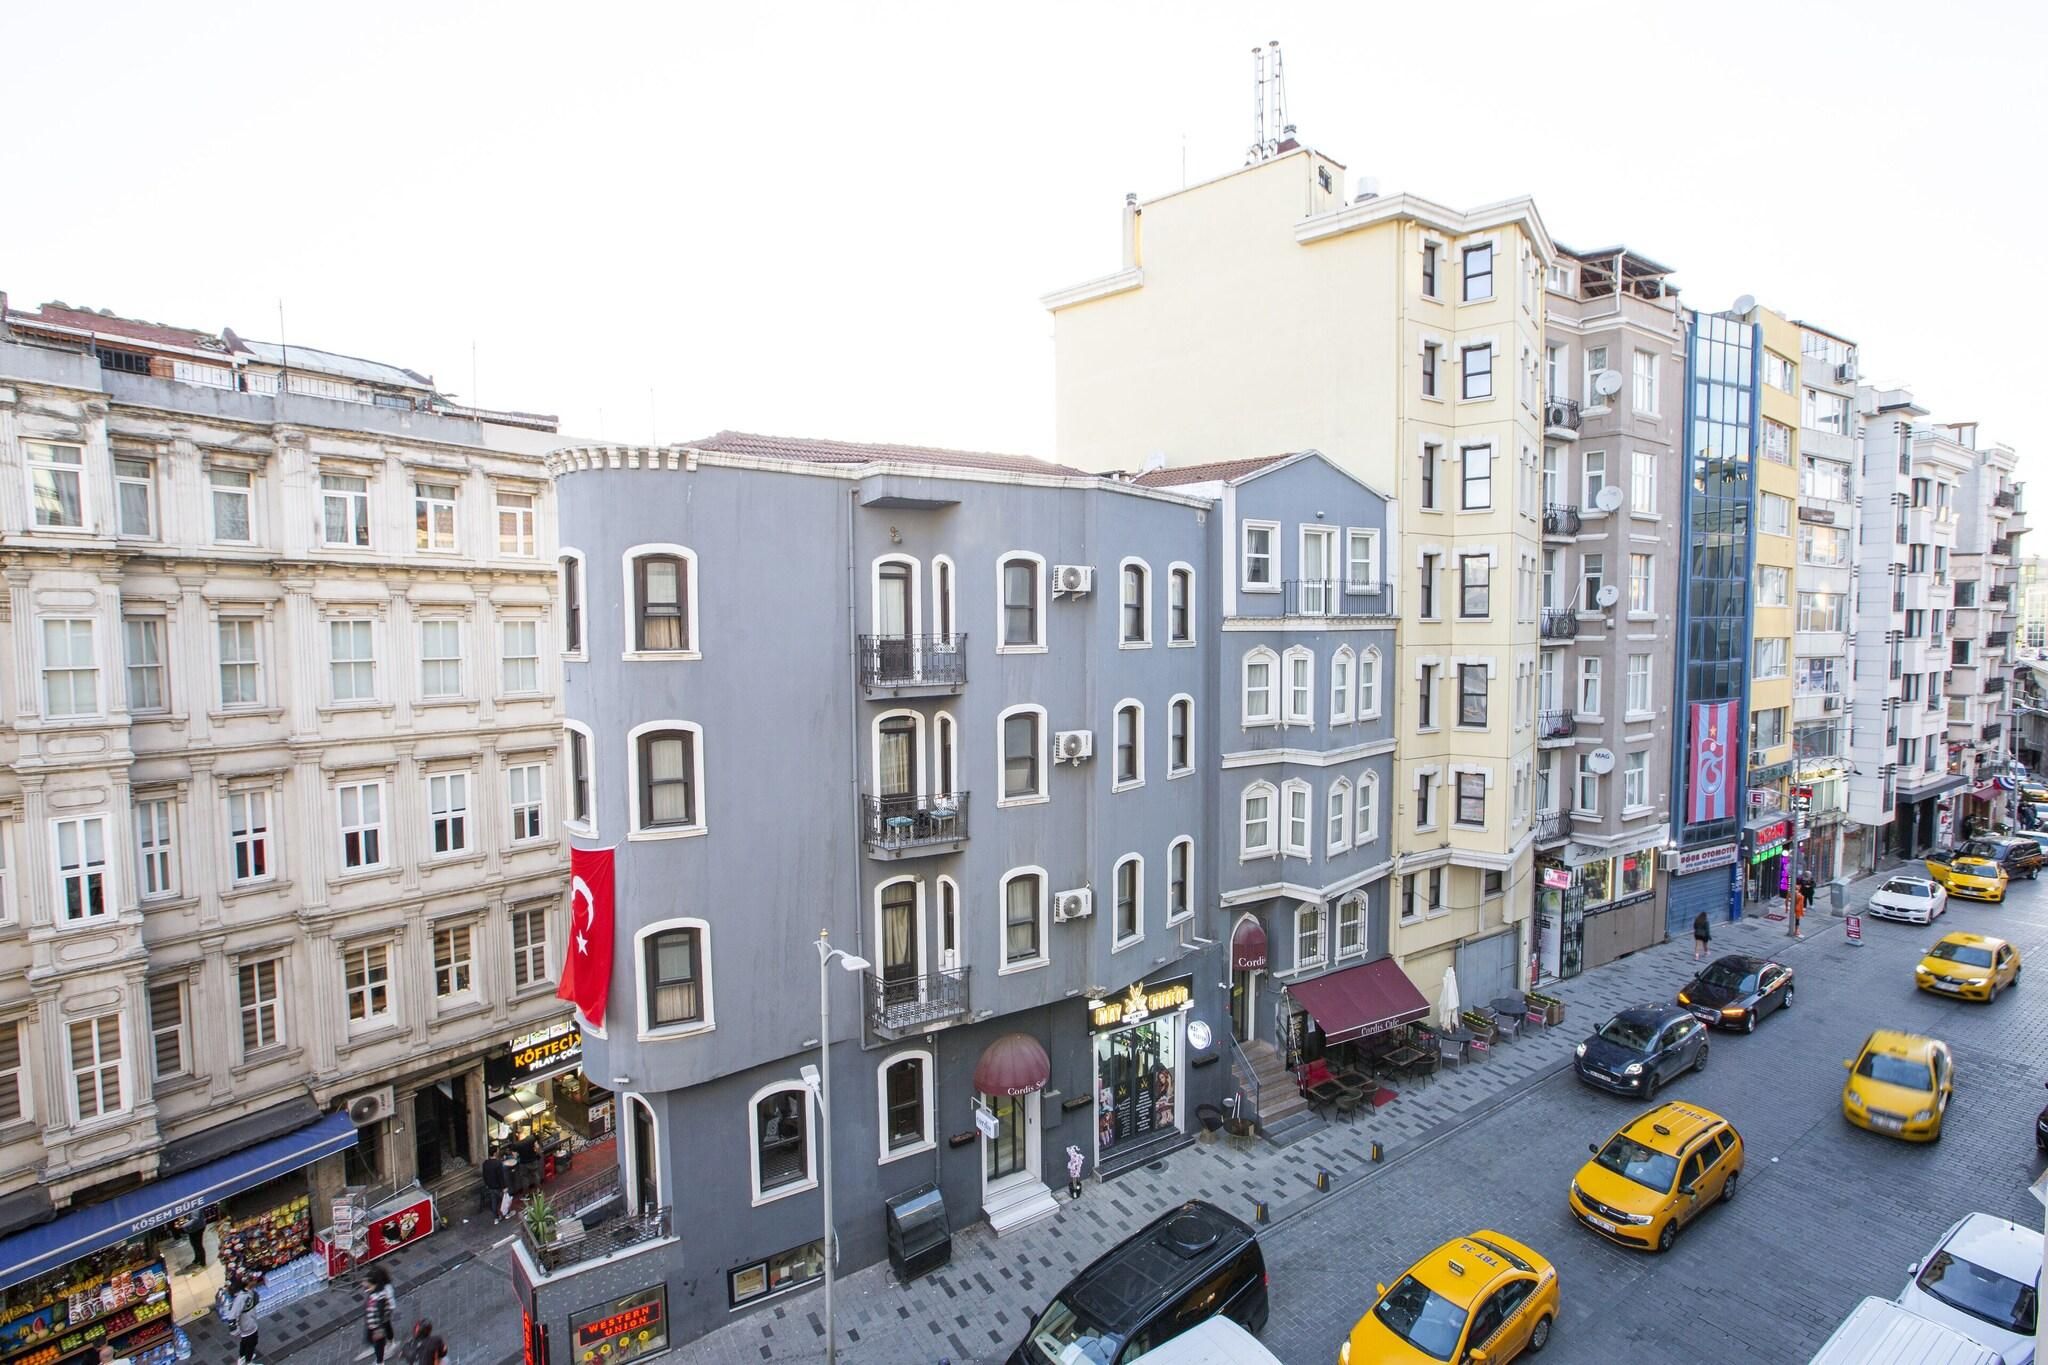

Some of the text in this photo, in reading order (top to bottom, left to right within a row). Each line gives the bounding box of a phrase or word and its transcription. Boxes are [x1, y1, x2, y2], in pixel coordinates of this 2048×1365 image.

[1007, 1083, 1035, 1096] Cordis
[588, 1306, 650, 1335] WESTERN
[604, 1315, 648, 1337] UNION
